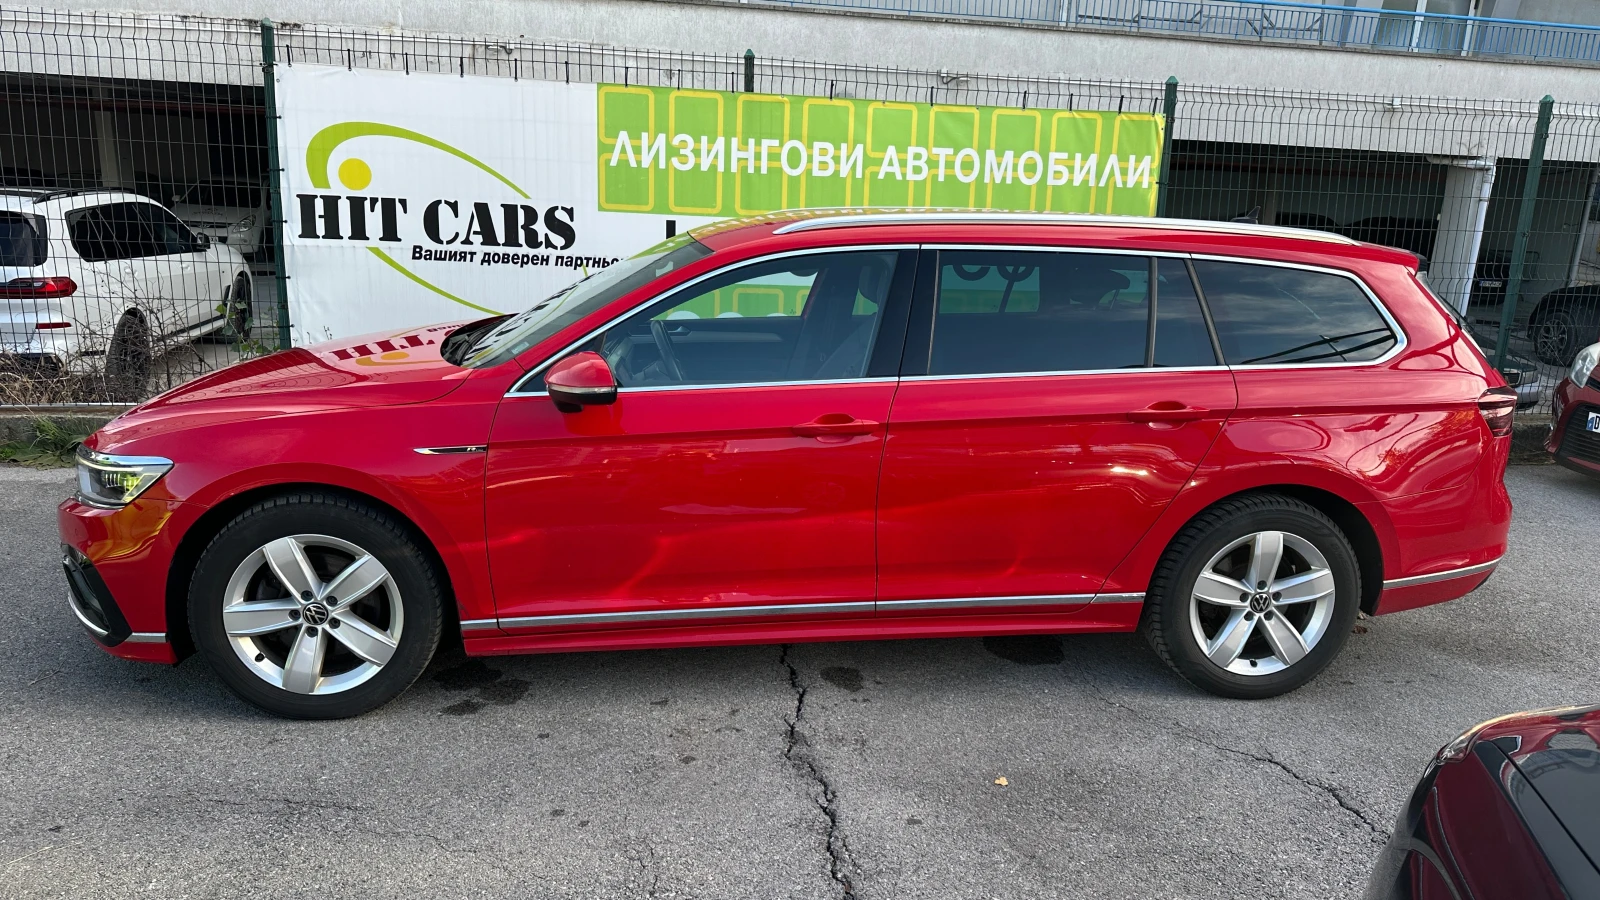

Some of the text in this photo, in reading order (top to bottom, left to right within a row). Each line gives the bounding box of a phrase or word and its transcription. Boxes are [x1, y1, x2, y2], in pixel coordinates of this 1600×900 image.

[610, 131, 1152, 188] ЛИЗИНГОВИ АВТОМОБИЛИ
[296, 194, 576, 250] HIT CARS
[411, 245, 623, 271] Вашият доверен партньо
